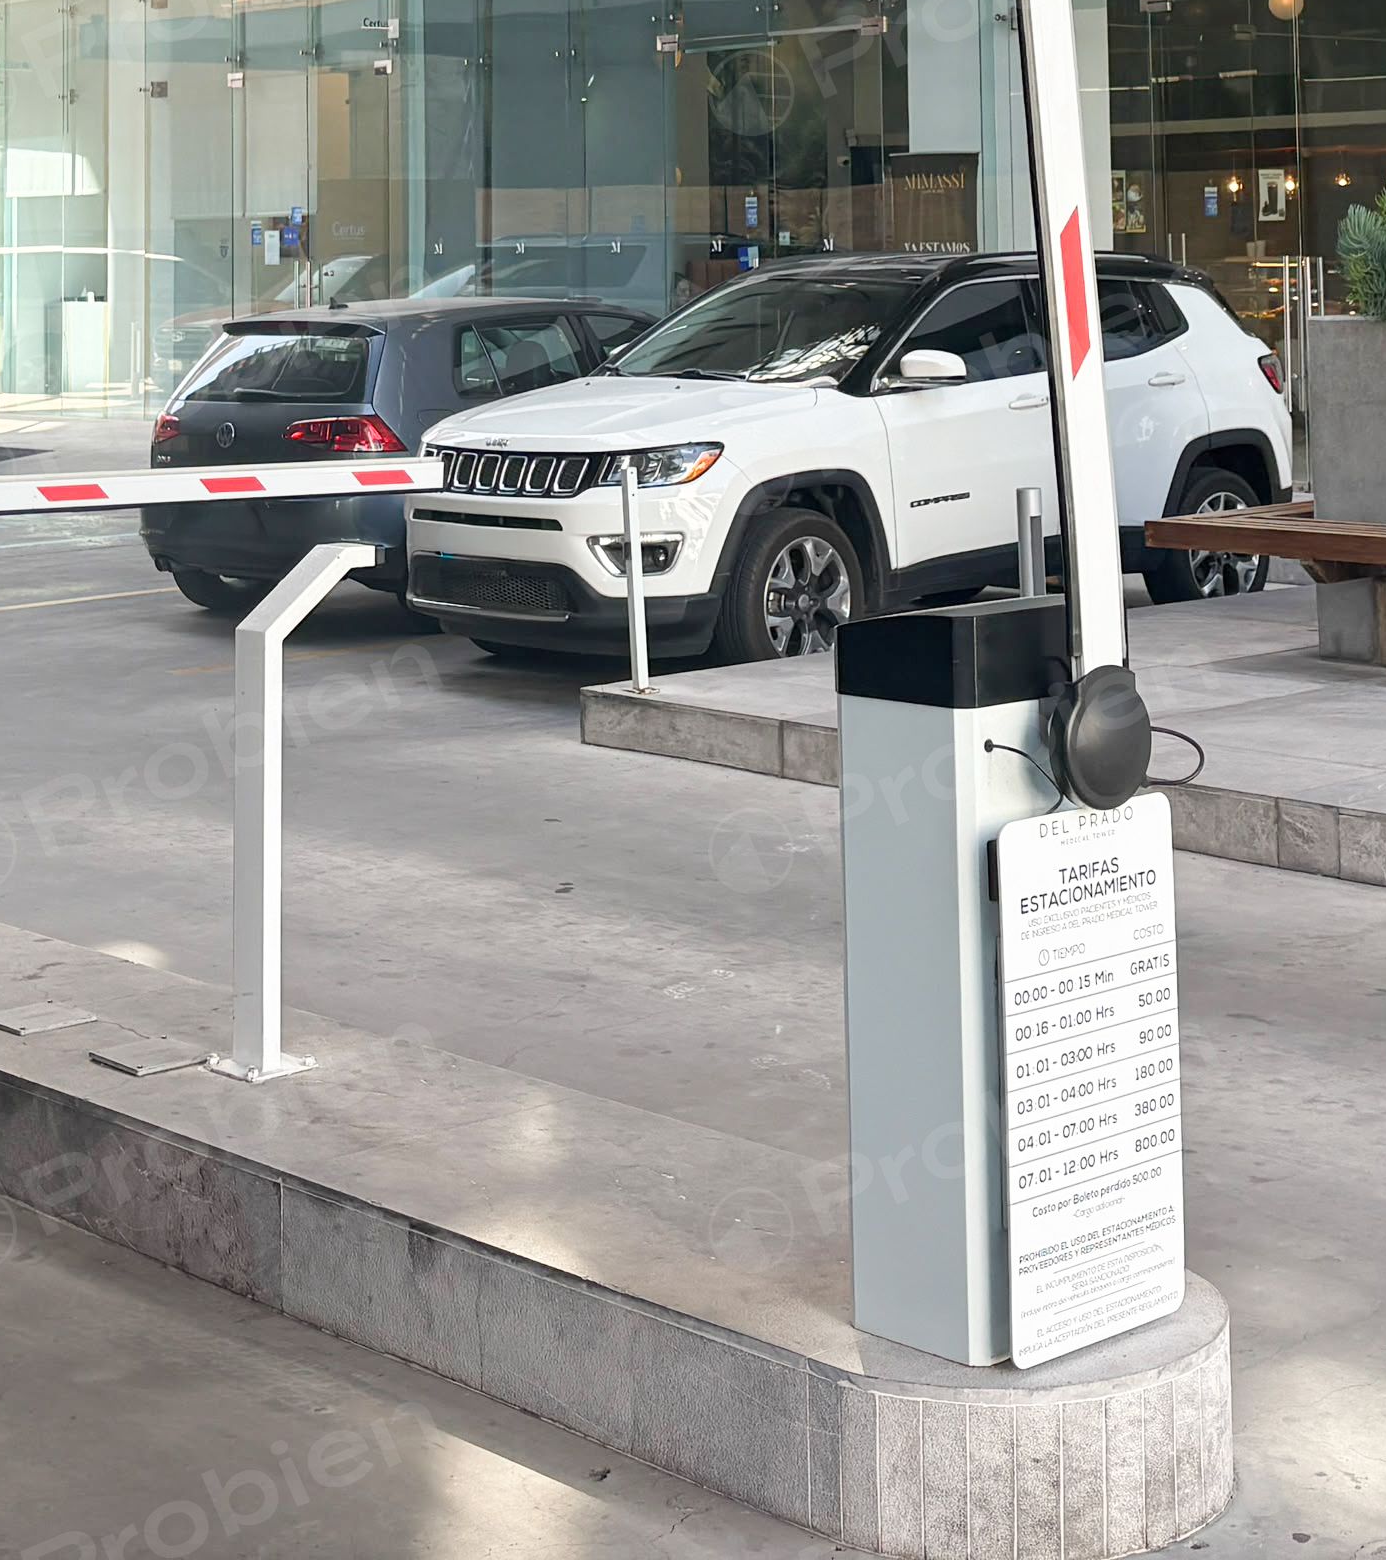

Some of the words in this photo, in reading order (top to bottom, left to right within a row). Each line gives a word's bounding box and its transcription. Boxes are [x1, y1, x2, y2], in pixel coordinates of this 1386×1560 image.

[1039, 820, 1069, 838] DEL
[1079, 806, 1133, 830] PRADO
[1059, 858, 1119, 884] TARIFAS
[1021, 869, 1156, 914] ESTACIONAMIENTO
[1053, 943, 1085, 960] TIEMPO
[1133, 924, 1164, 940] COSTO
[1095, 970, 1114, 985] Min
[1130, 954, 1170, 975] GRATIS
[1096, 1006, 1115, 1021] Hrs
[1138, 988, 1171, 1007] 50.00
[1097, 1043, 1116, 1057] Hrs
[1139, 1024, 1171, 1044] 90.00
[1098, 1078, 1117, 1092] Hrs
[1135, 1058, 1173, 1081] 180.00
[1099, 1113, 1117, 1128] Hrs
[1134, 1093, 1174, 1116] 380.00
[1100, 1150, 1119, 1164] Hrs
[1135, 1129, 1175, 1152] 800.00
[1032, 1204, 1056, 1218] Costo
[1058, 1199, 1071, 1212] por
[1073, 1190, 1099, 1205] Boleto
[1101, 1177, 1131, 1197] perdido
[1019, 1243, 1059, 1264] PROHIBIDO
[1061, 1241, 1069, 1250] EL
[1071, 1235, 1087, 1247] USO
[1088, 1231, 1100, 1243] DEL
[1103, 1209, 1167, 1236] ESTACIONAMIENTO
[1019, 1251, 1073, 1276] PROVEEDORES
[1080, 1226, 1144, 1255] REPRESENTANTES
